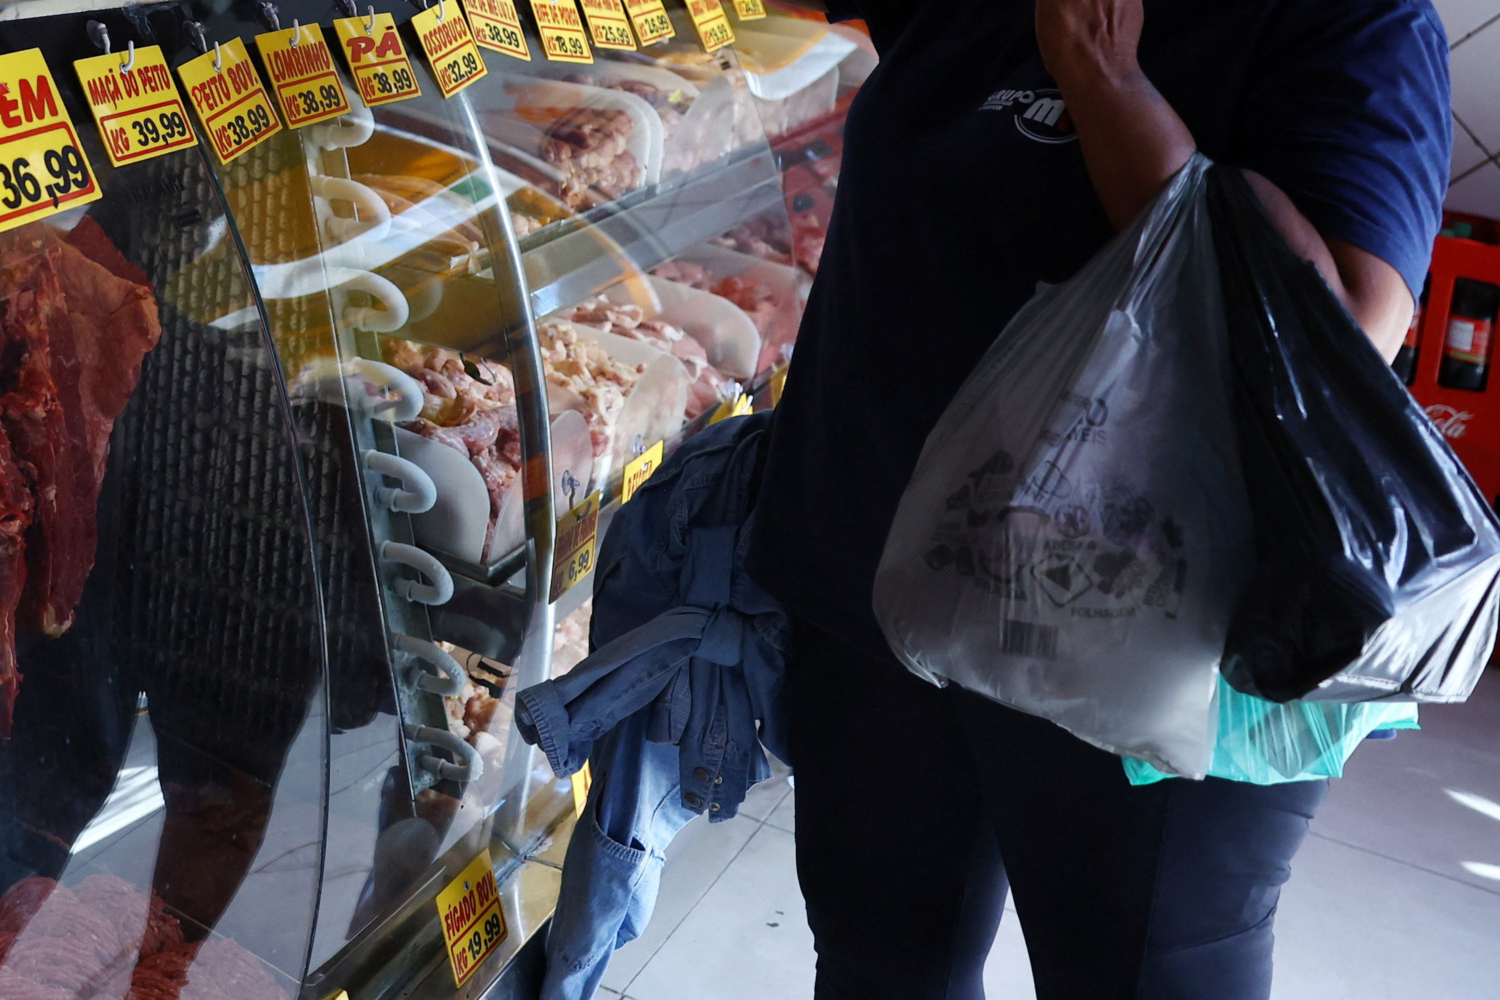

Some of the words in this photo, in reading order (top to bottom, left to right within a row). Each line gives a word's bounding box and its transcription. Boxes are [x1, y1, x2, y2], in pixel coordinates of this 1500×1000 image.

[423, 16, 467, 57] OSSOBUCO
[121, 70, 139, 99] DO
[138, 63, 171, 96] PEITO
[266, 40, 331, 83] LOMBINHO
[439, 67, 450, 88] KG
[448, 53, 478, 83] 32,99
[191, 73, 231, 115] PEITO
[228, 59, 258, 94] BOV.
[285, 95, 301, 119] KG
[298, 84, 341, 115] 38,99
[361, 76, 375, 99] KG
[373, 68, 412, 94] 38,99
[110, 127, 130, 155] KG
[132, 111, 187, 147] 39,99
[215, 125, 231, 154] KG
[226, 104, 270, 146] 38,99
[568, 549, 590, 581] 6,99
[444, 889, 476, 941] FÍGADO
[476, 870, 497, 905] BOV.
[455, 947, 468, 976] KG
[468, 913, 500, 961] 19,99
